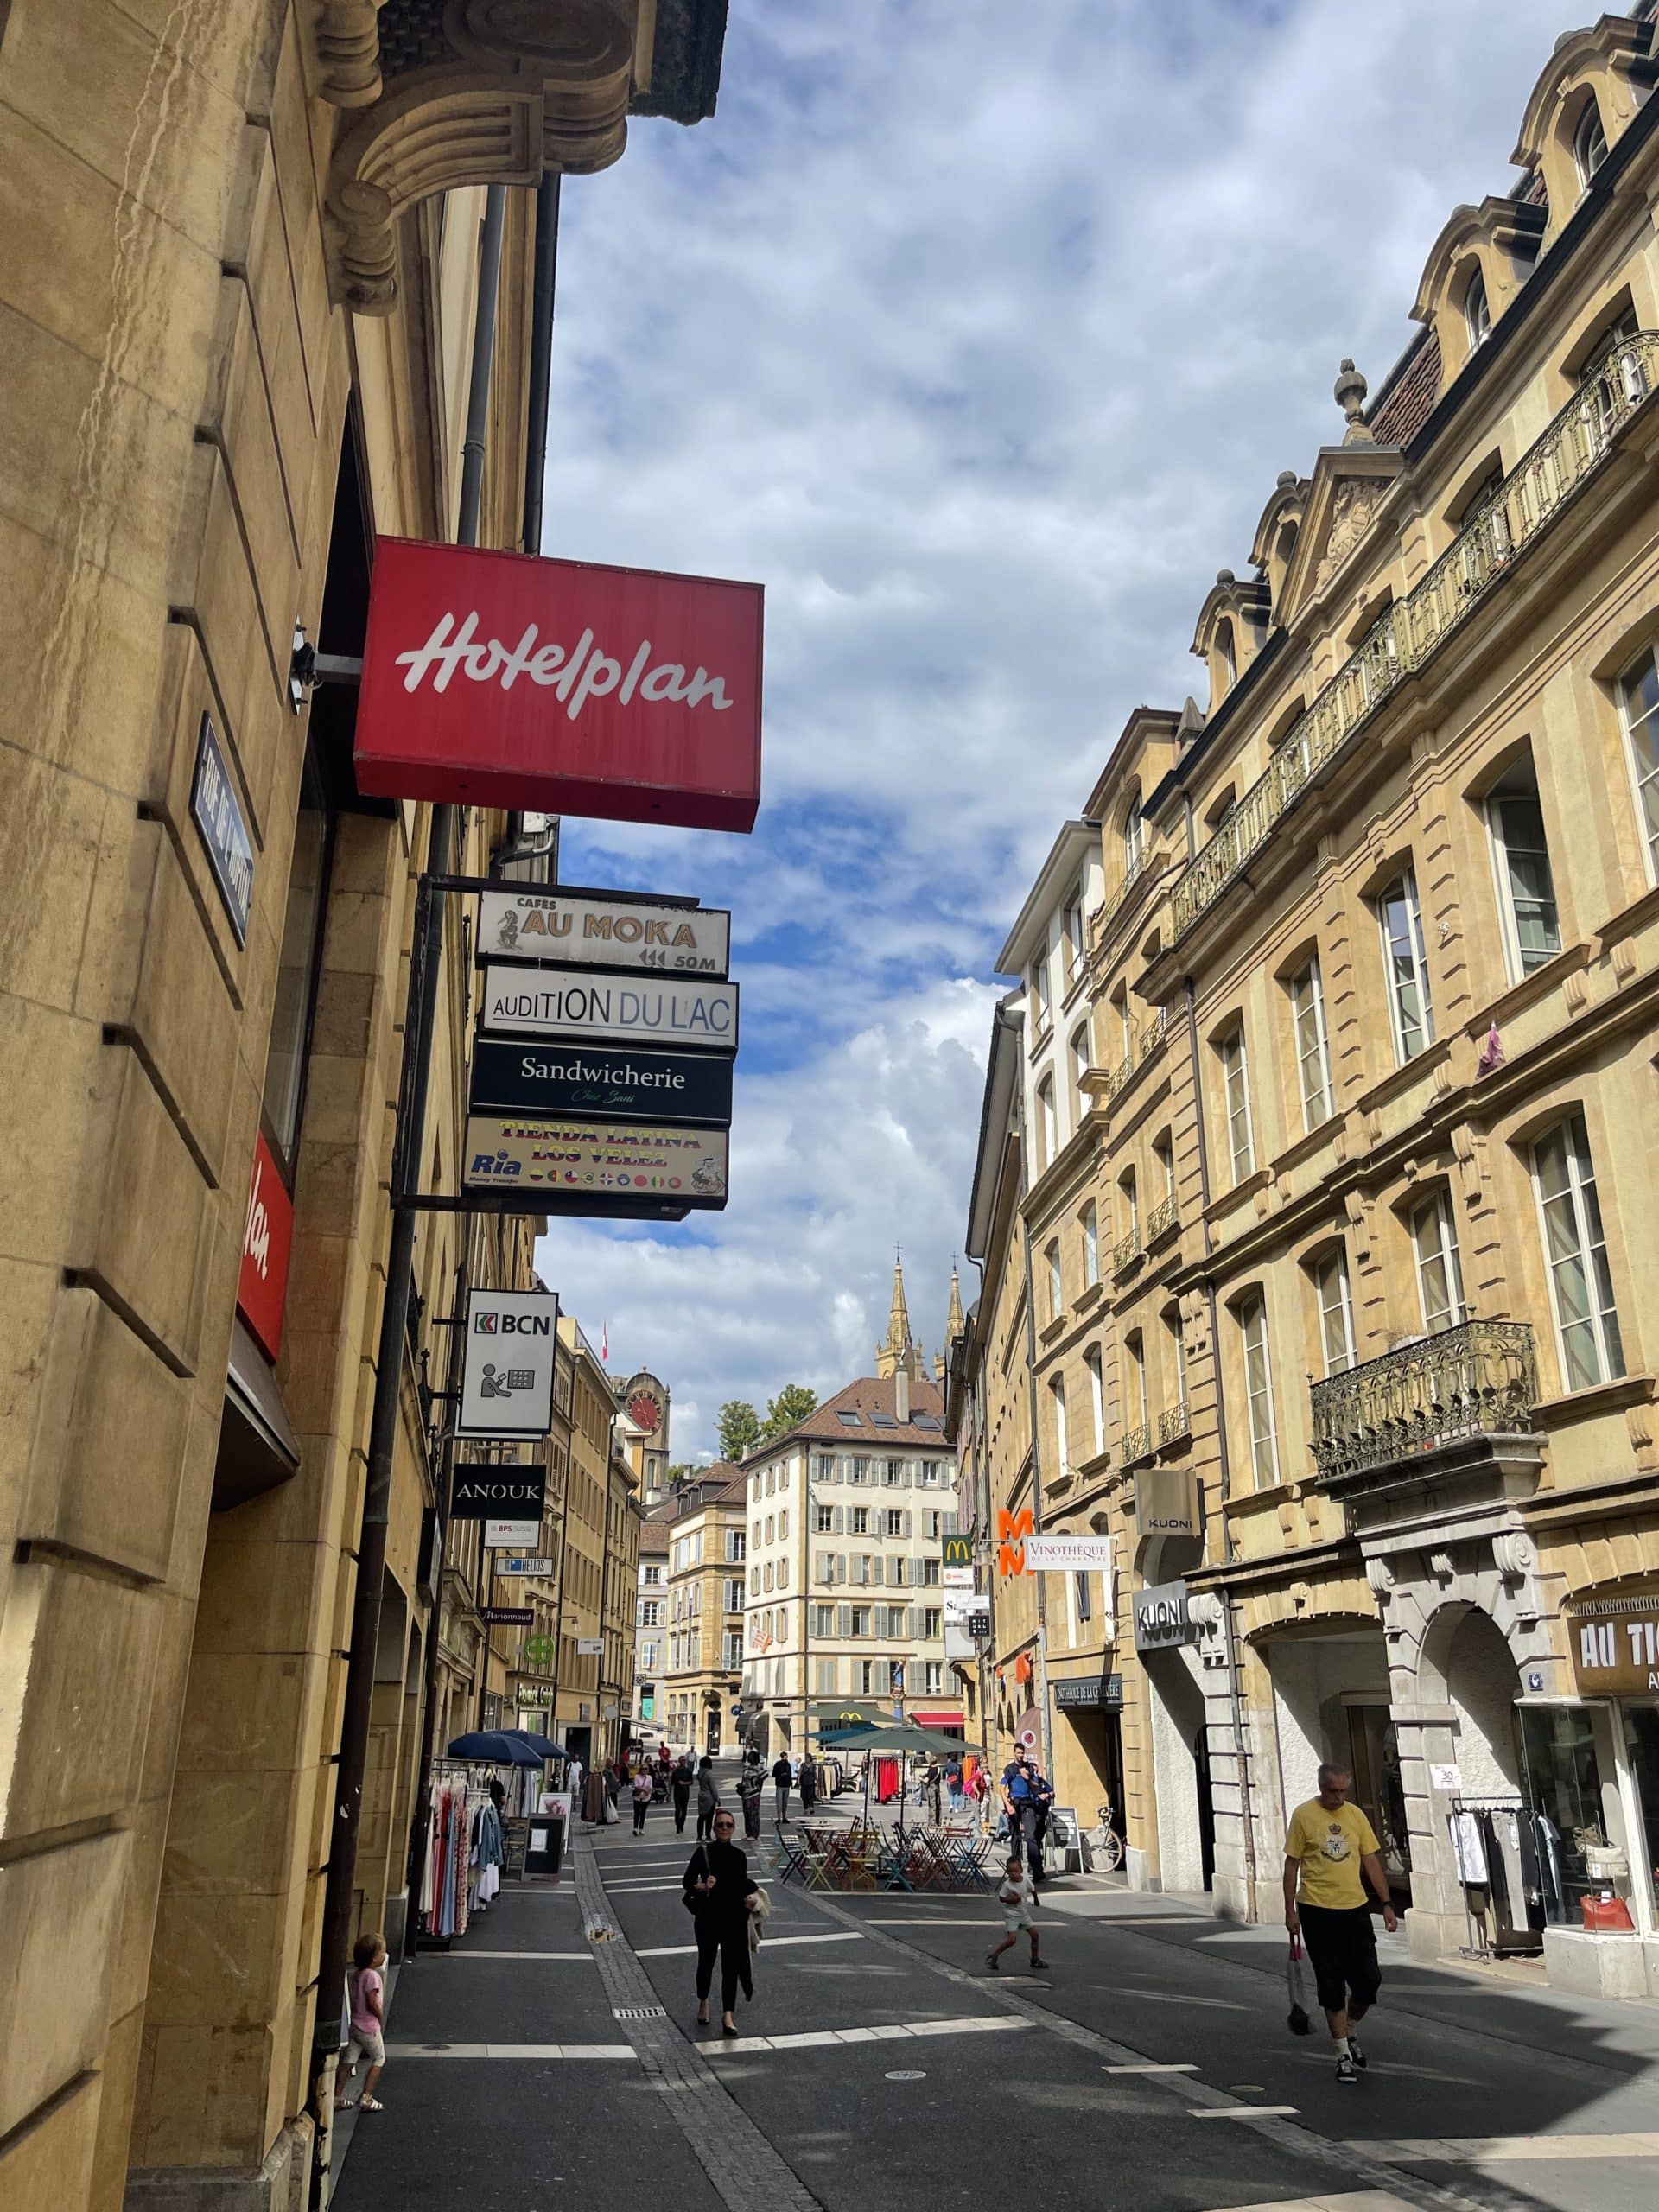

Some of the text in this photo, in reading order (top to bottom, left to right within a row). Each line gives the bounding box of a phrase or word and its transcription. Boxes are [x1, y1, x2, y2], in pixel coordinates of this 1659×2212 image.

[394, 610, 734, 721] Hotelplan
[202, 747, 221, 824] RUE
[520, 909, 698, 949] AU MOKA
[493, 988, 730, 1032] AUDITION DU LAC
[521, 1057, 685, 1089] Sandwicherie
[499, 1120, 702, 1149] TIENDA LATINA
[471, 1149, 522, 1175] Ria
[531, 1143, 669, 1167] LOS VELEZ
[501, 1314, 550, 1336] BCN
[456, 1484, 540, 1499] ANOUK
[1148, 1519, 1192, 1529] KUONI
[522, 1559, 545, 1572] HELIOS
[1138, 1597, 1183, 1631] KUONI
[1580, 1622, 1616, 1668] AU
